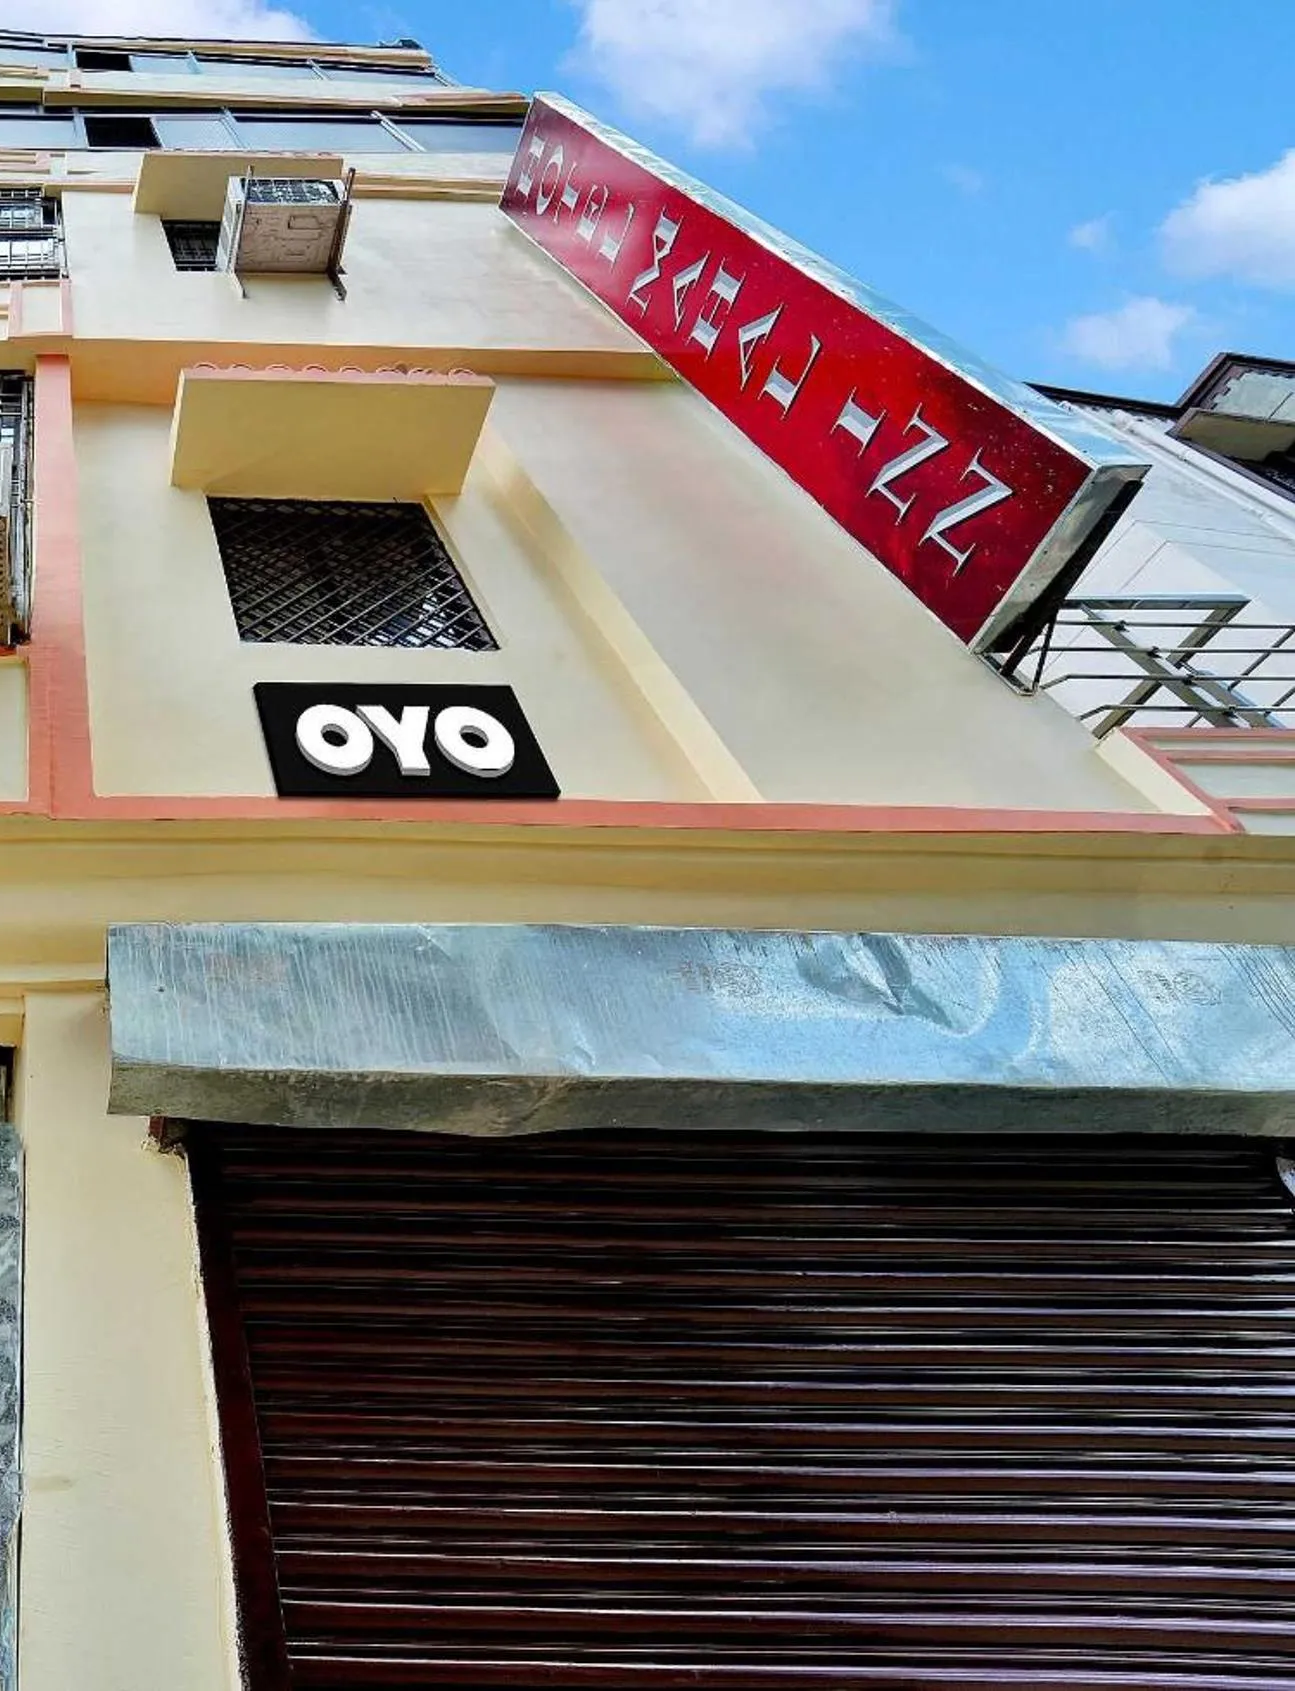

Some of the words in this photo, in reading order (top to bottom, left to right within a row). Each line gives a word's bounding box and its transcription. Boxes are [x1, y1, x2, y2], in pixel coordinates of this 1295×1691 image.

[515, 127, 635, 275] HOTEL
[624, 203, 822, 420] MAHAL
[829, 386, 1015, 579] INN
[295, 703, 515, 778] OYO
